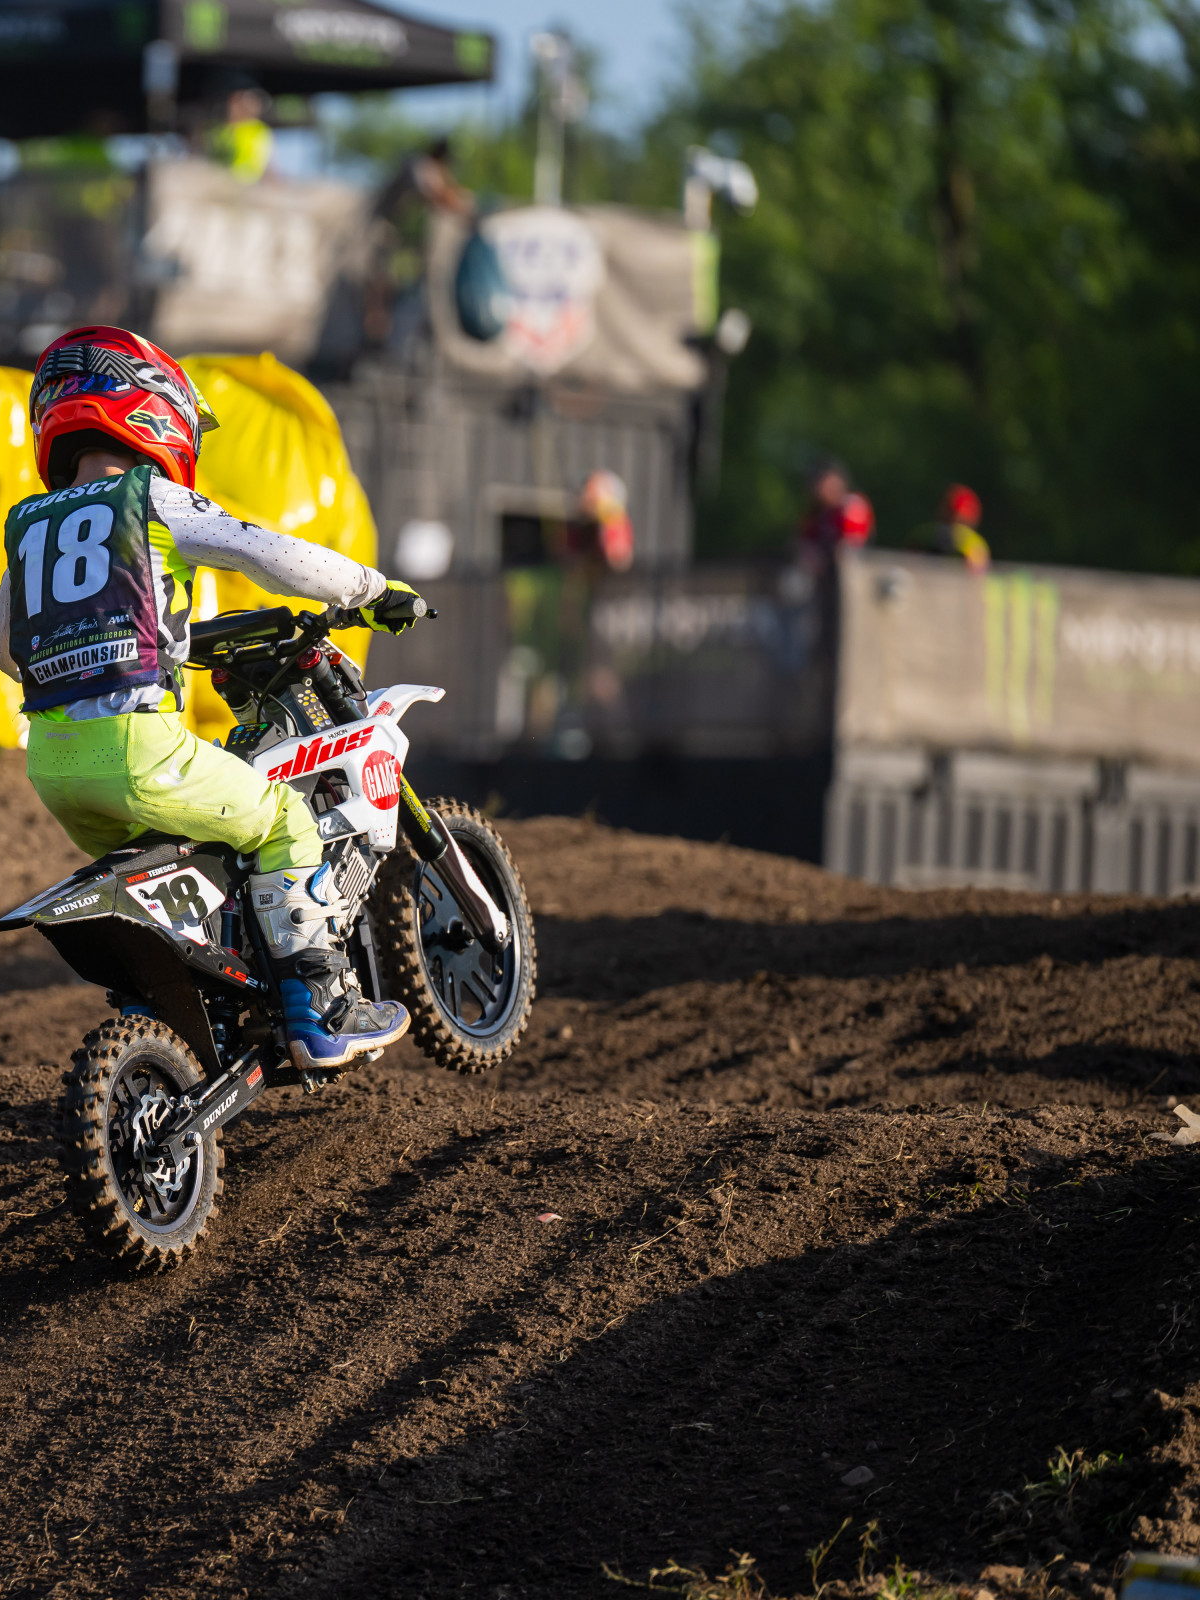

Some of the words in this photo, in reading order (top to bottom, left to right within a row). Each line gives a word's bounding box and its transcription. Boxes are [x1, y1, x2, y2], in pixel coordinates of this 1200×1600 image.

[18, 503, 115, 619] 18
[29, 646, 53, 663] AMATEUR
[55, 637, 86, 653] NATIONAL
[88, 628, 133, 643] MOTOCROSS
[35, 642, 135, 681] CHAMPIONSHIP
[52, 894, 101, 916] DUNLOP
[147, 902, 161, 911] AMA
[149, 874, 209, 932] 18
[258, 892, 274, 902] TECH
[224, 966, 259, 989] LS2
[202, 1090, 239, 1131] DUNLOP
